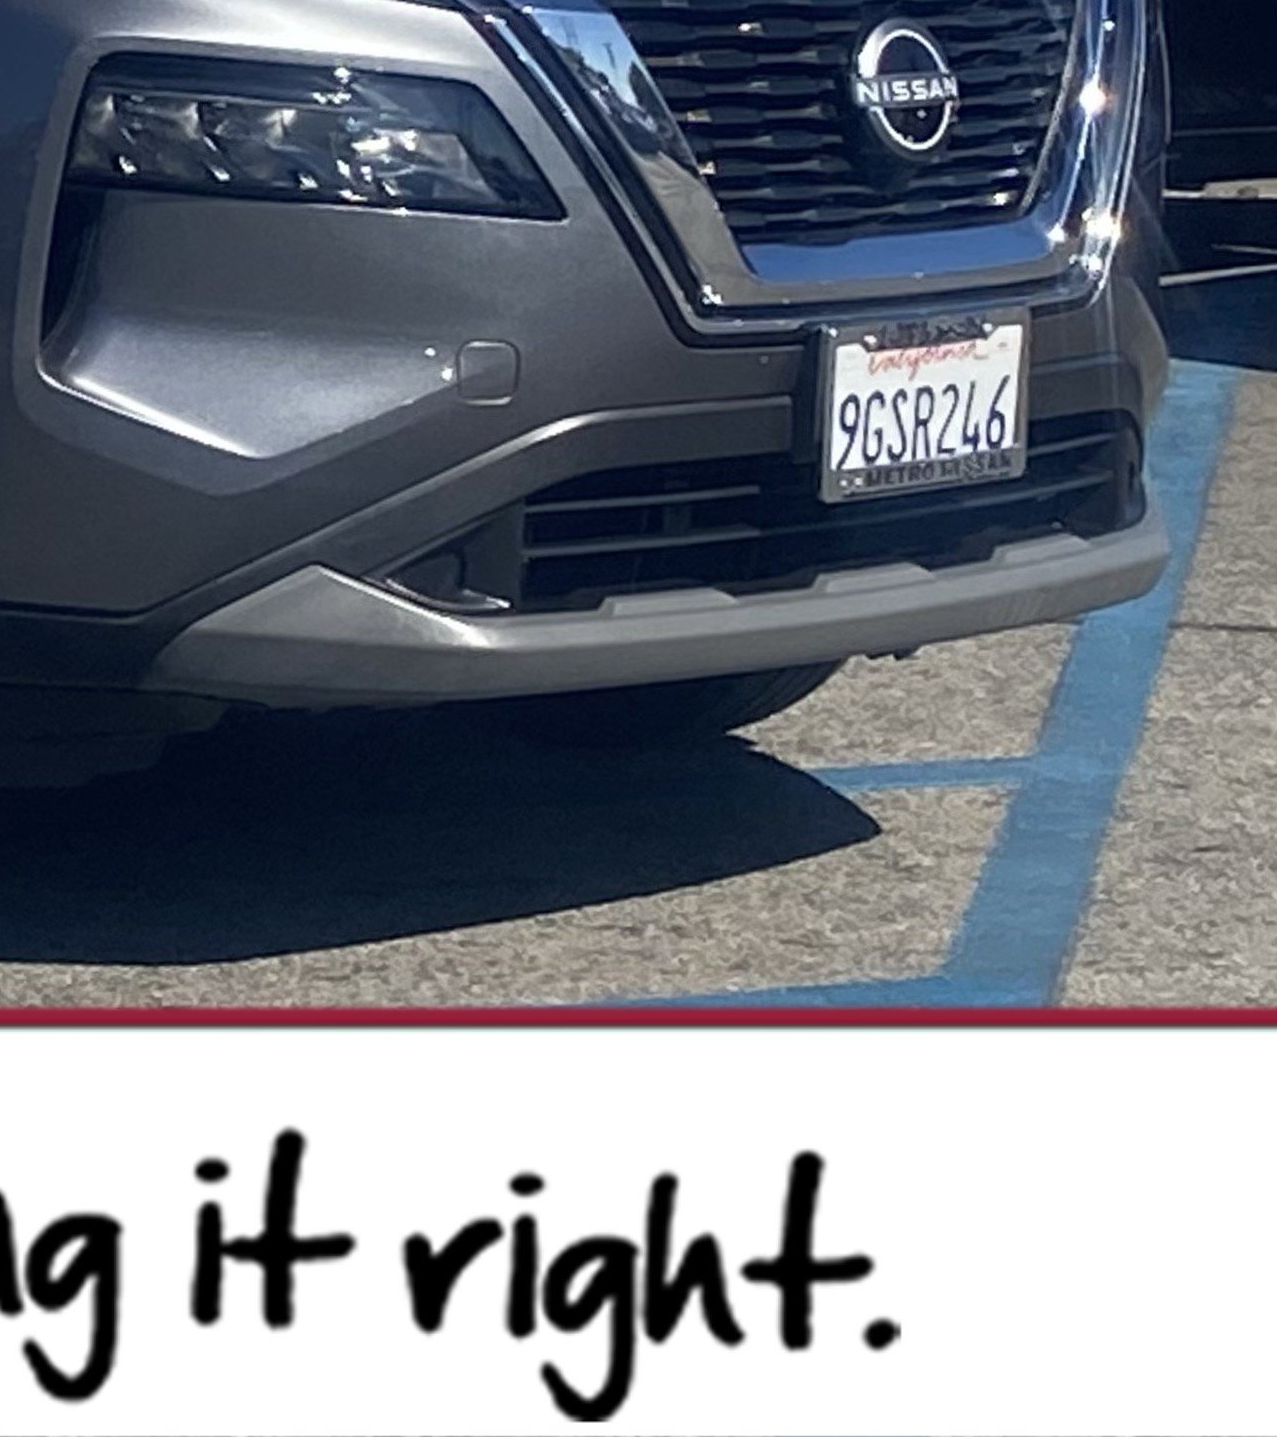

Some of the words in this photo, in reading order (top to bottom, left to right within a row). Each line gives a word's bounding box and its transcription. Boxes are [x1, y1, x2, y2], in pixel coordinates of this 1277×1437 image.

[855, 76, 958, 103] NISSAN
[867, 340, 988, 381] California
[836, 374, 1010, 470] 9GSR246
[865, 462, 935, 487] METRO
